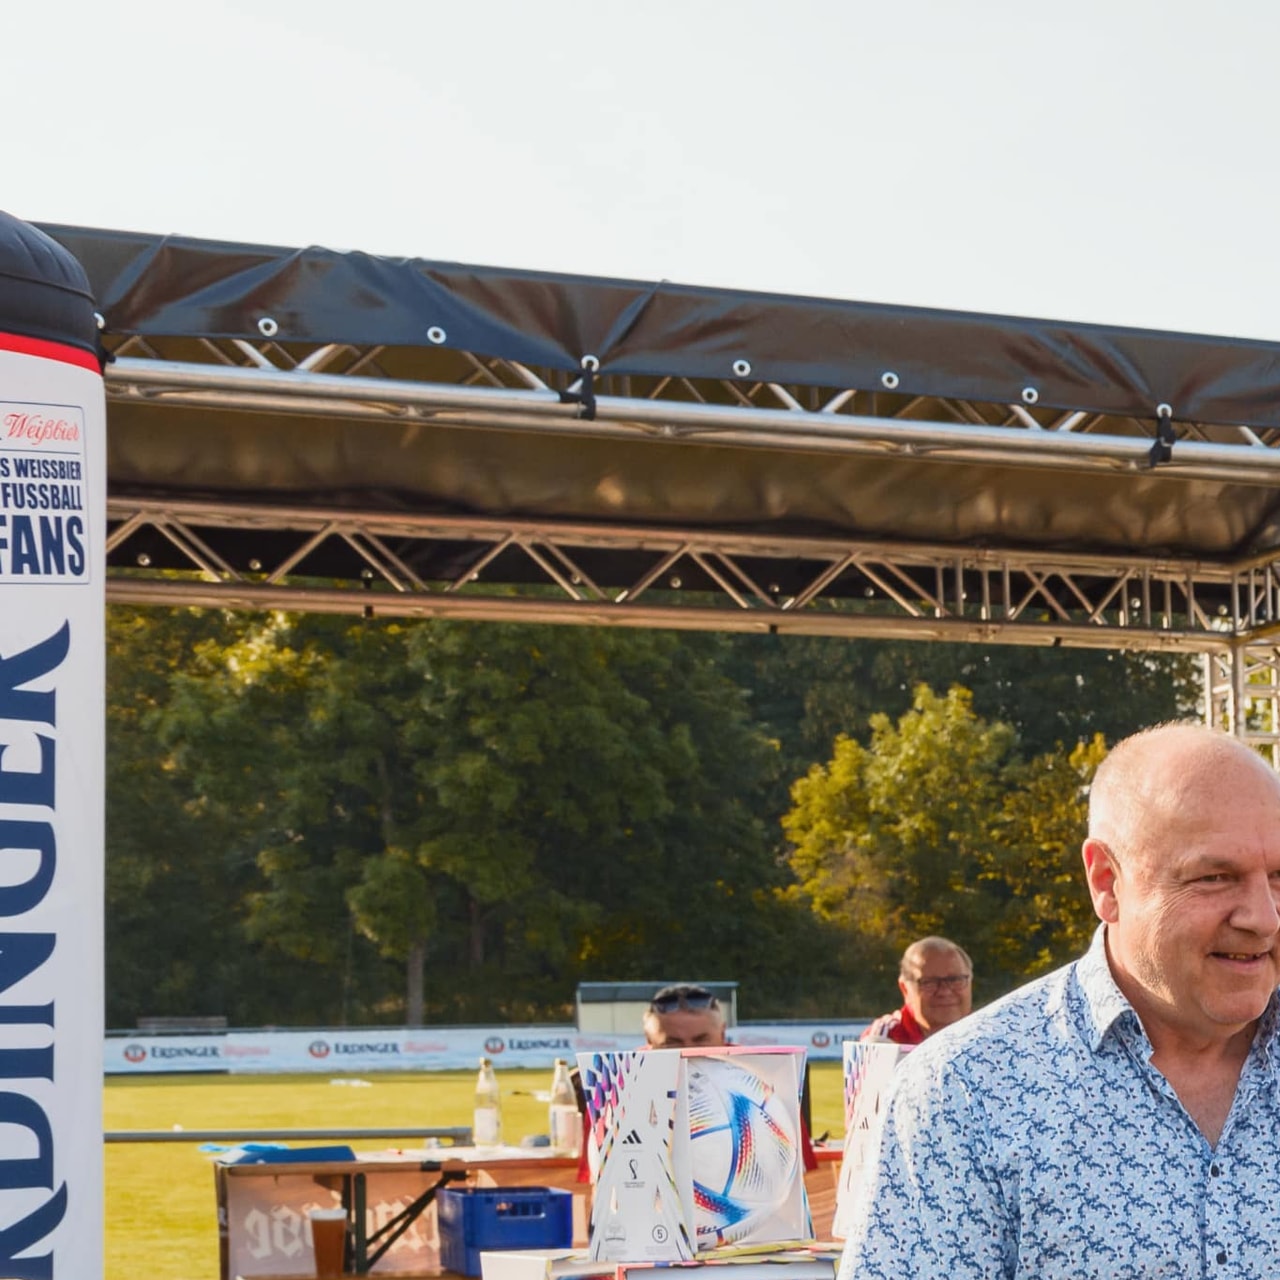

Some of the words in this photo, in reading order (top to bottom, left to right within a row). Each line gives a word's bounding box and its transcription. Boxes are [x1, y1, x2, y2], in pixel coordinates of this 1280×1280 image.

[14, 458, 82, 481] WEISSBIER
[1, 482, 83, 511] FUSSBALL
[0, 515, 85, 577] FANS
